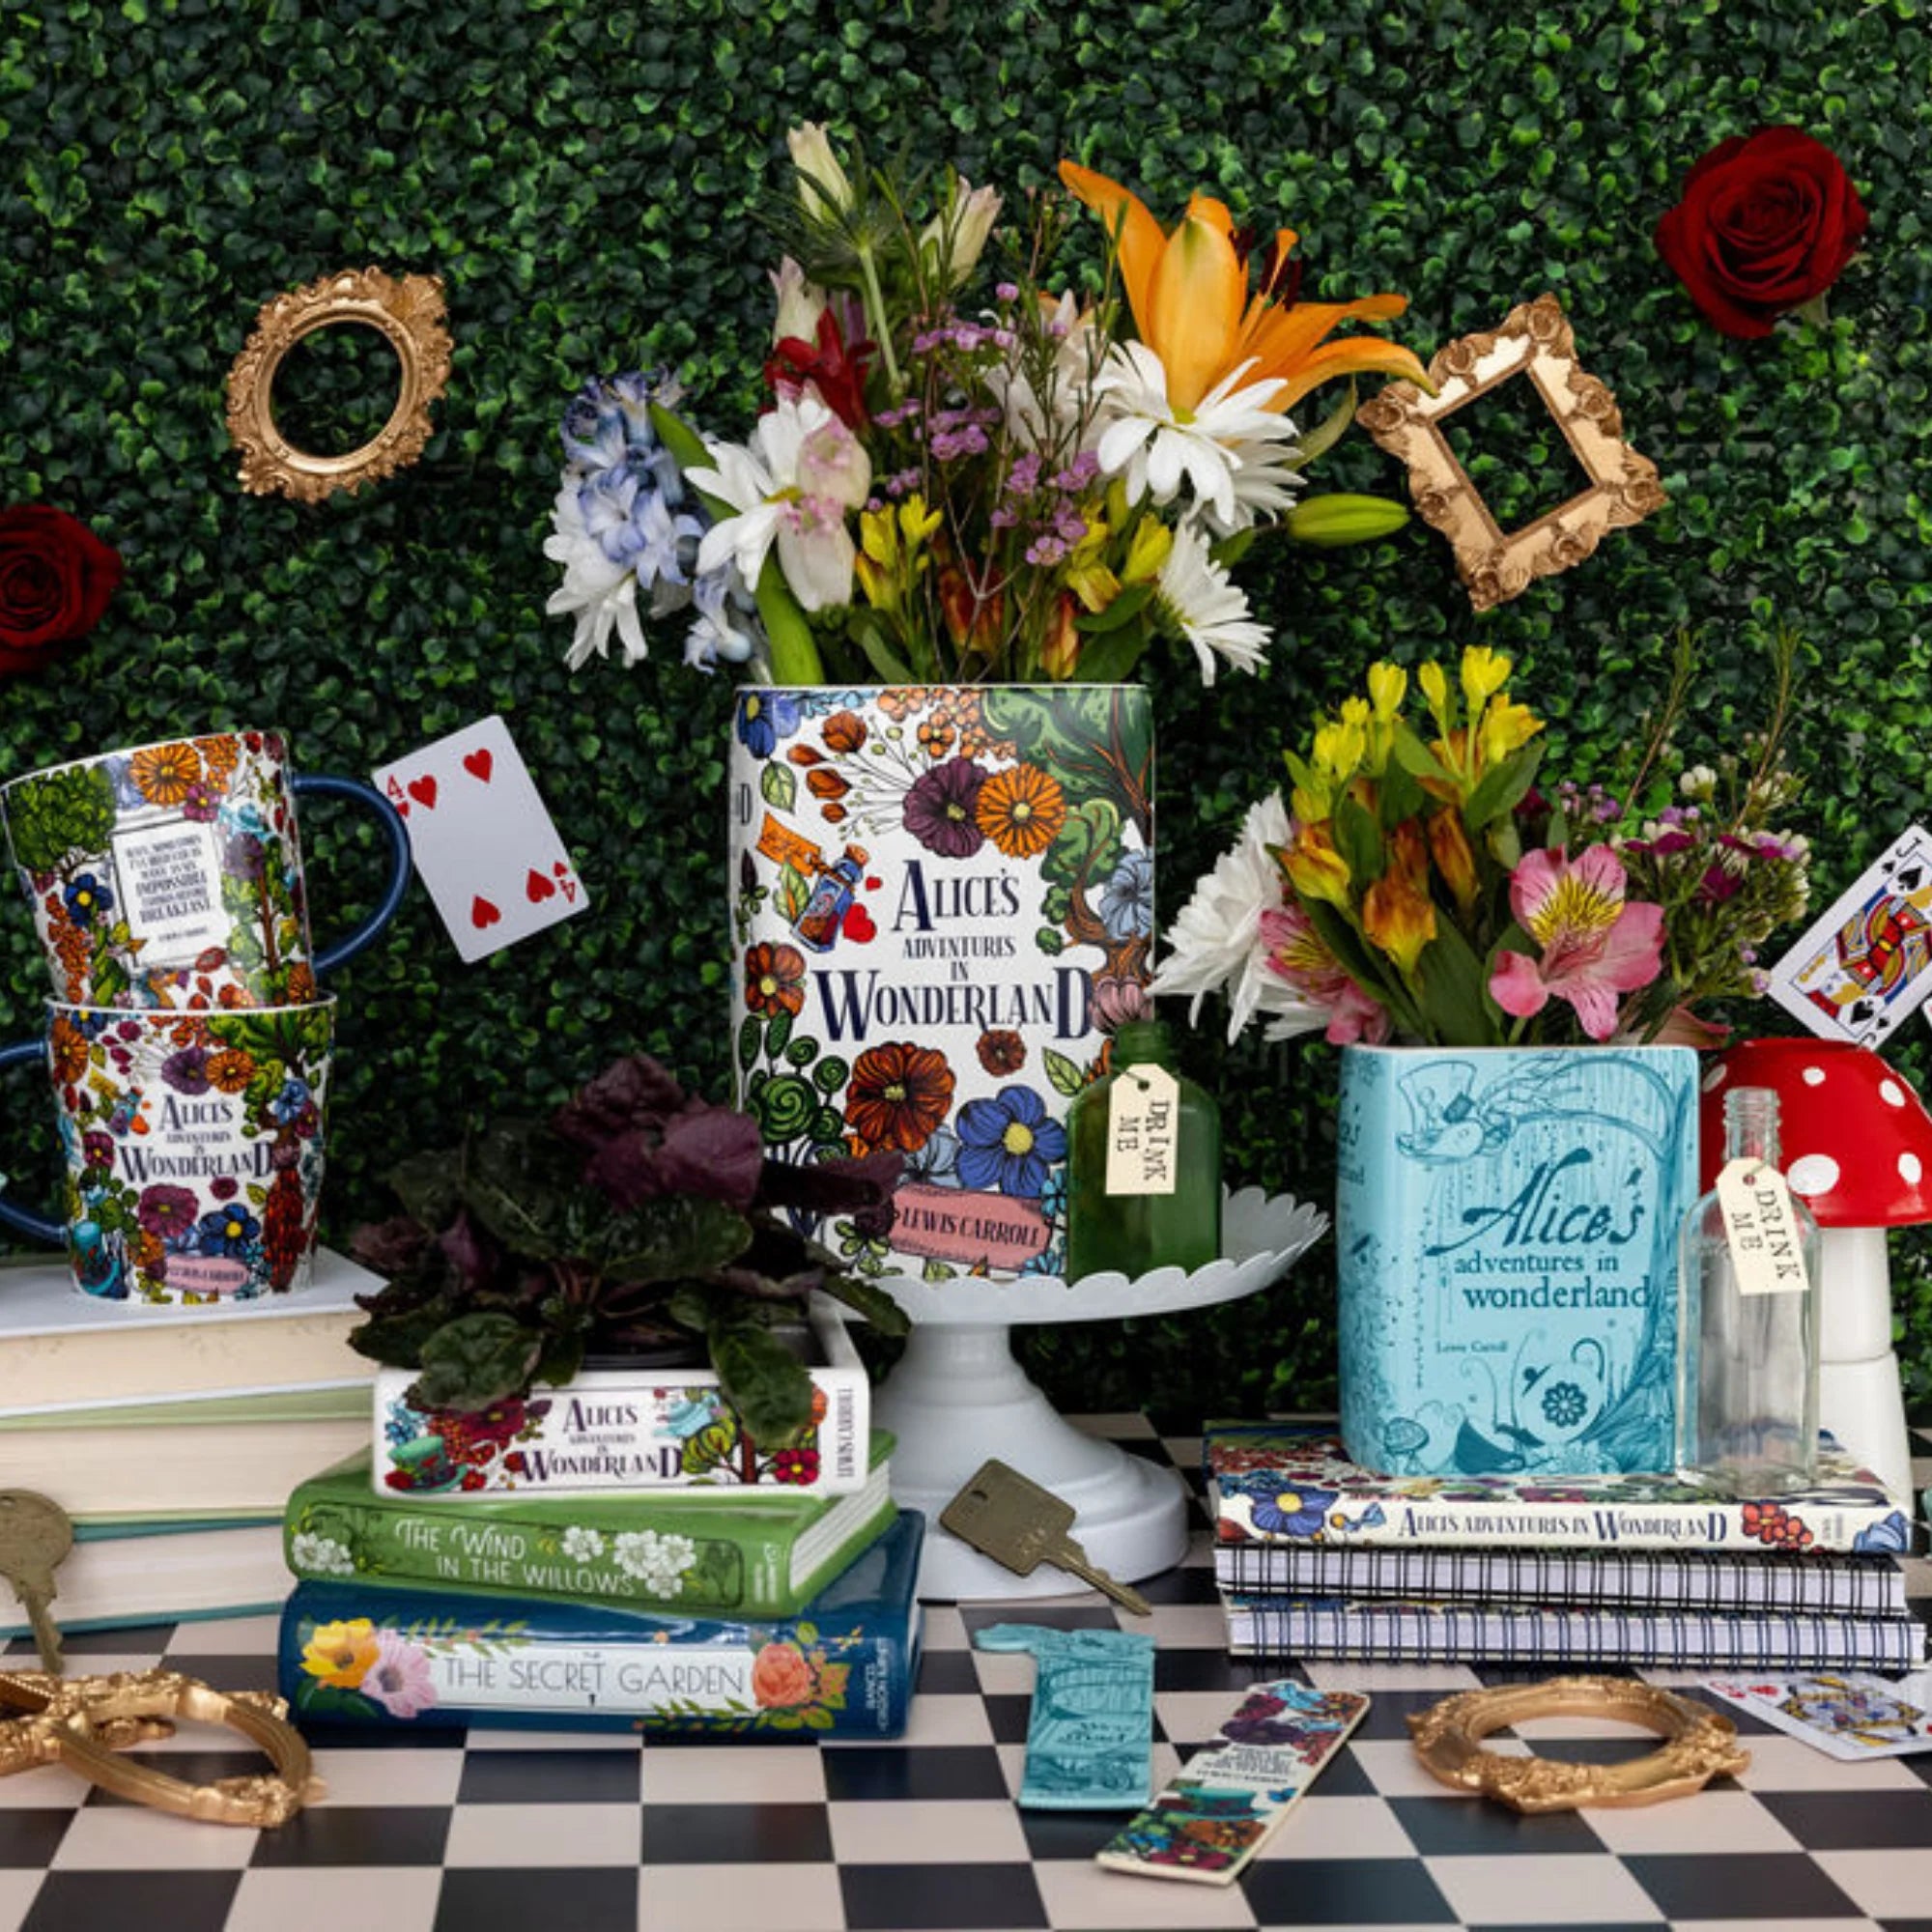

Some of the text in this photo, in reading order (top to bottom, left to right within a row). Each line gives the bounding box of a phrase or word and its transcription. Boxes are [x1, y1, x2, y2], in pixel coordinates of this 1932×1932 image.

[387, 774, 405, 799] 4
[1895, 836, 1922, 859] J
[557, 879, 576, 904] 4
[891, 859, 1020, 932] ALICE'S
[902, 935, 1017, 960] ADVENTURES
[950, 961, 969, 981] IN
[810, 966, 1093, 1042] WONDERLAND
[1117, 1113, 1140, 1152] ME
[1143, 1098, 1170, 1181] DRINK
[117, 1140, 274, 1183] WONDERLAND
[1425, 1148, 1645, 1256] Alice's
[901, 1207, 1040, 1248] LEWIS CARROLL
[1731, 1211, 1764, 1250] ME
[1754, 1189, 1801, 1280] DRINK
[1453, 1250, 1620, 1274] adventures in
[1462, 1274, 1650, 1309] wonderland
[518, 1445, 684, 1482] WONDERLAND
[394, 1519, 526, 1561] THE WIND
[1463, 1515, 1569, 1535] ADVENTURES
[1572, 1517, 1589, 1535] IN
[1593, 1510, 1727, 1544] WONDERLAND
[437, 1554, 635, 1597] IN THE WILLOWS
[444, 1657, 744, 1694] THE SECRET GARDEN
